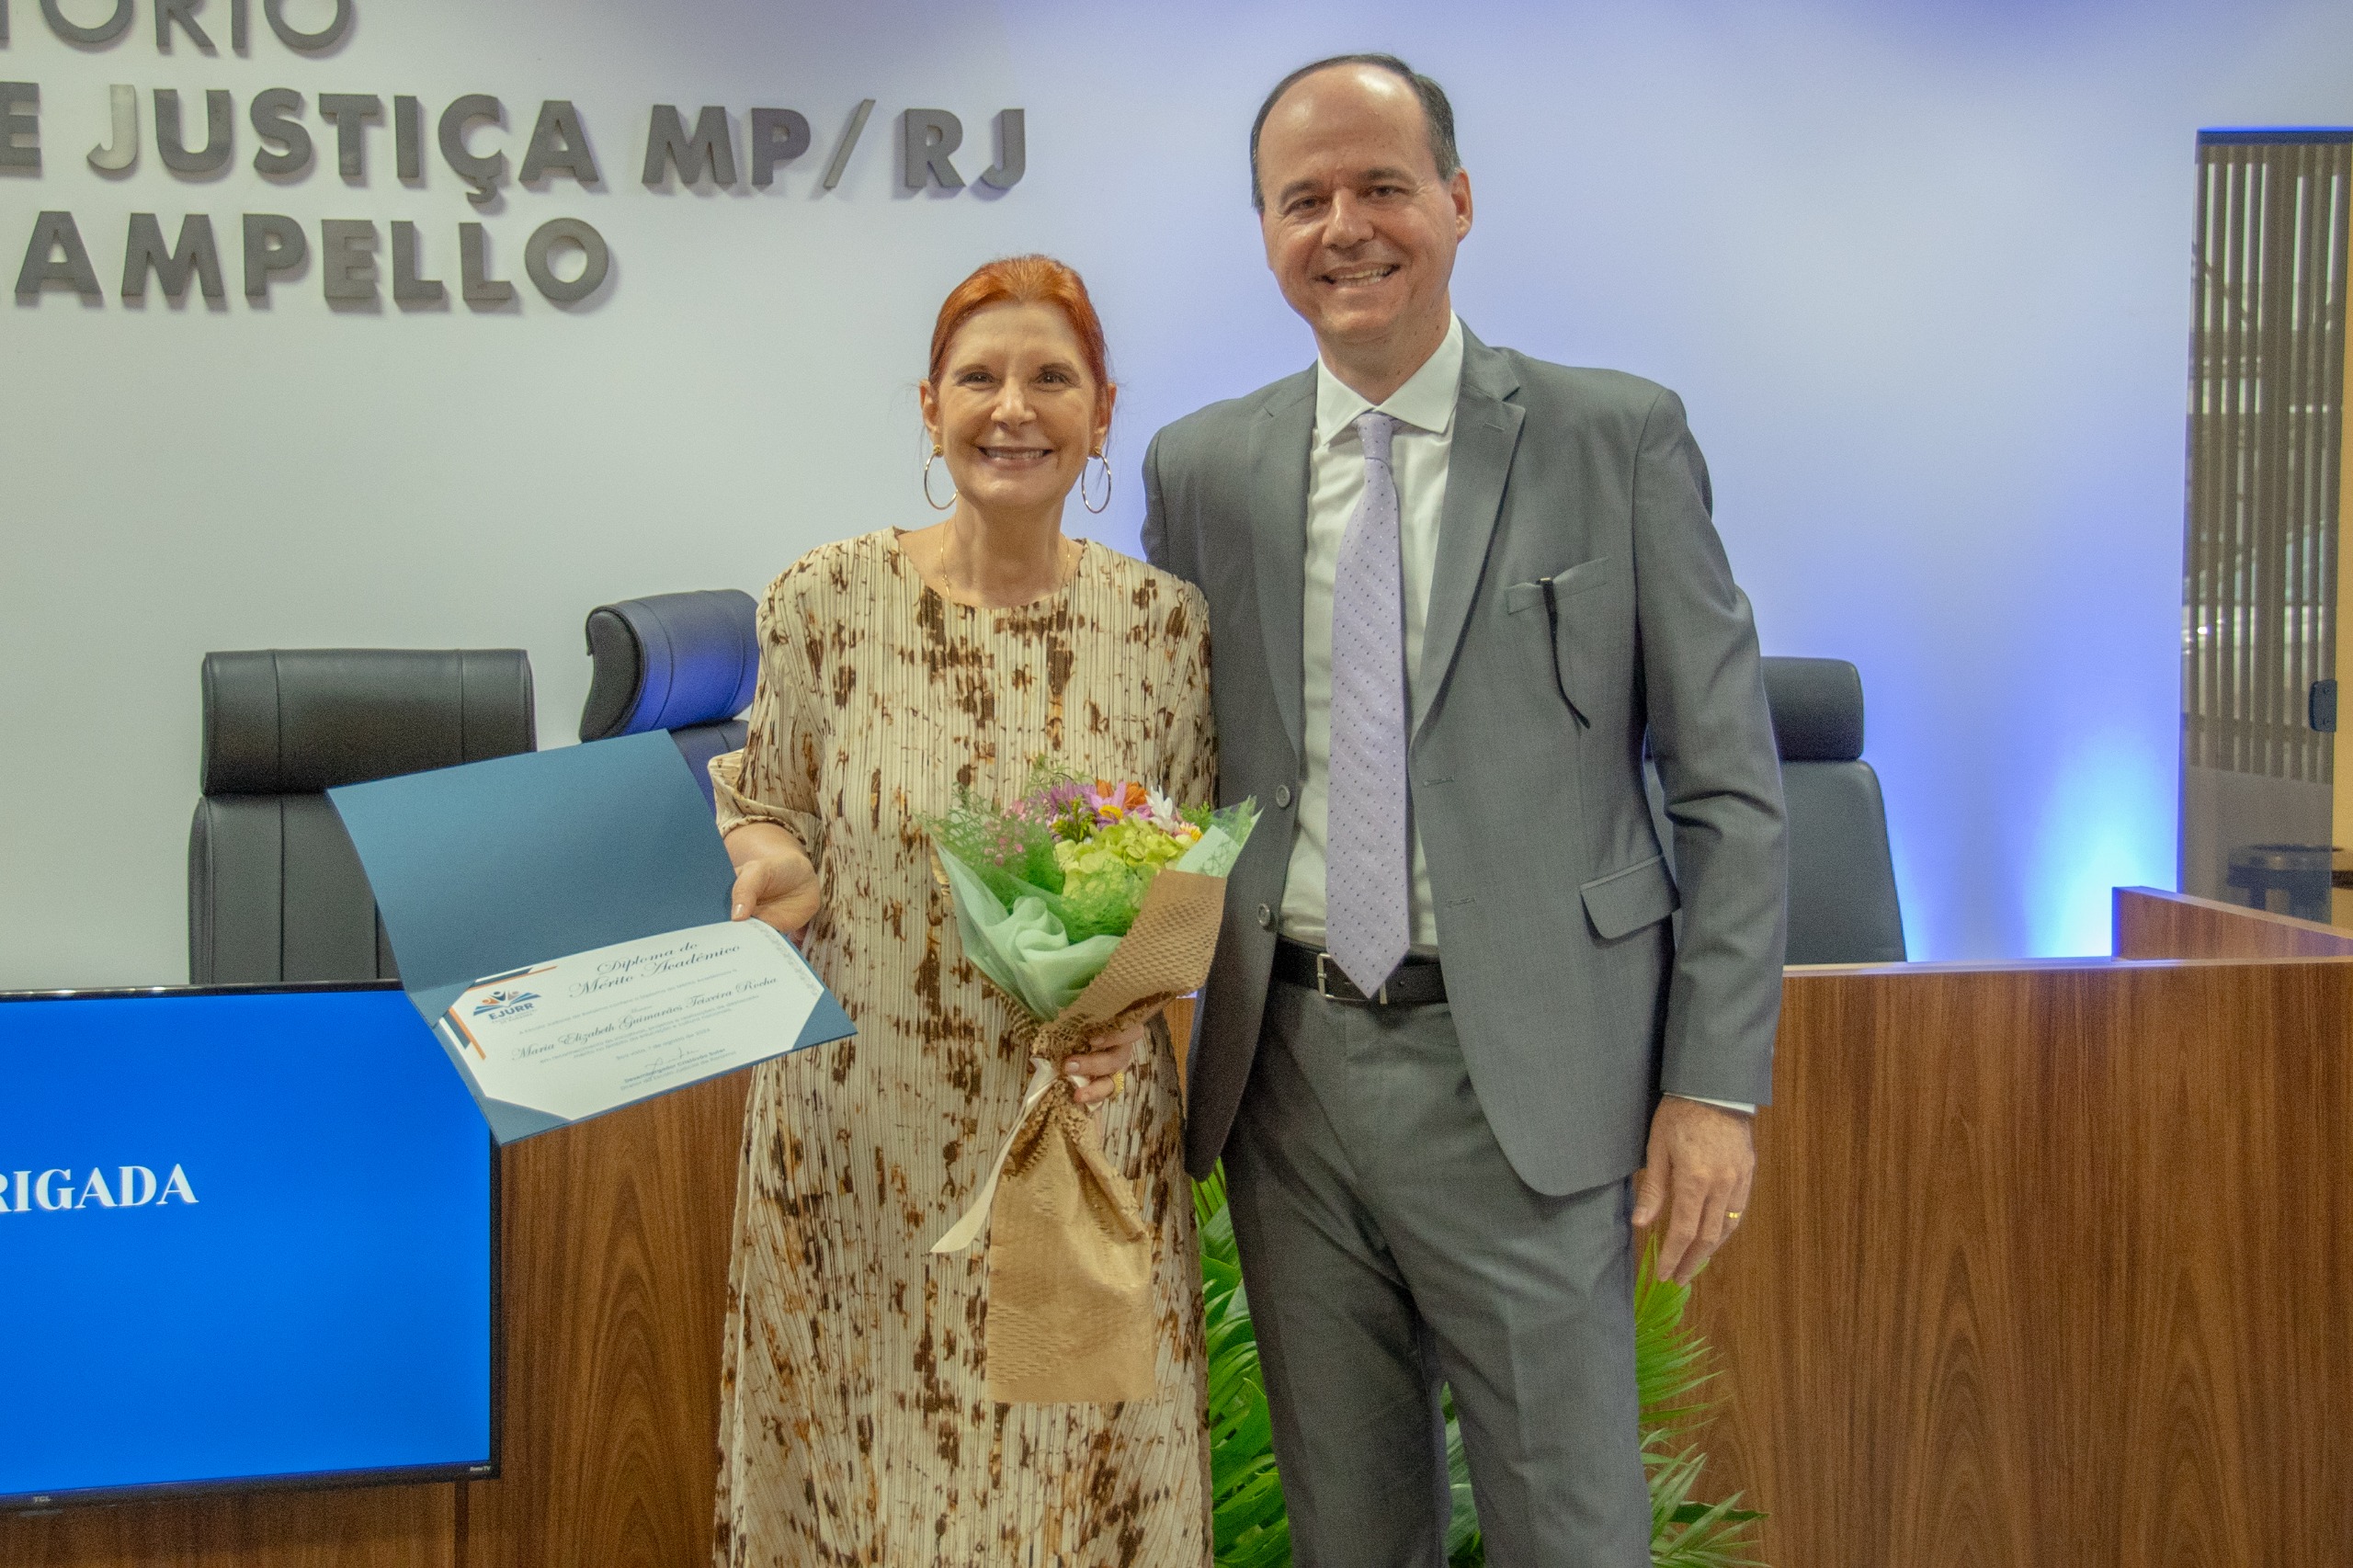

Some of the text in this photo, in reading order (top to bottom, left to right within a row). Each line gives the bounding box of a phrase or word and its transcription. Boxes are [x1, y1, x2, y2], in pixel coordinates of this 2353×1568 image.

[87, 85, 601, 204] JUSTIÇA
[15, 210, 610, 302] AMPELLO
[569, 975, 633, 999] Mérito
[641, 945, 740, 978] Acadêmico
[597, 949, 673, 975] Diploma
[488, 1003, 534, 1020] EJURR
[511, 1043, 554, 1061] Maria
[558, 1023, 614, 1045] Elizabeth
[686, 990, 732, 1008] Teixeira
[735, 977, 777, 994] Rocha
